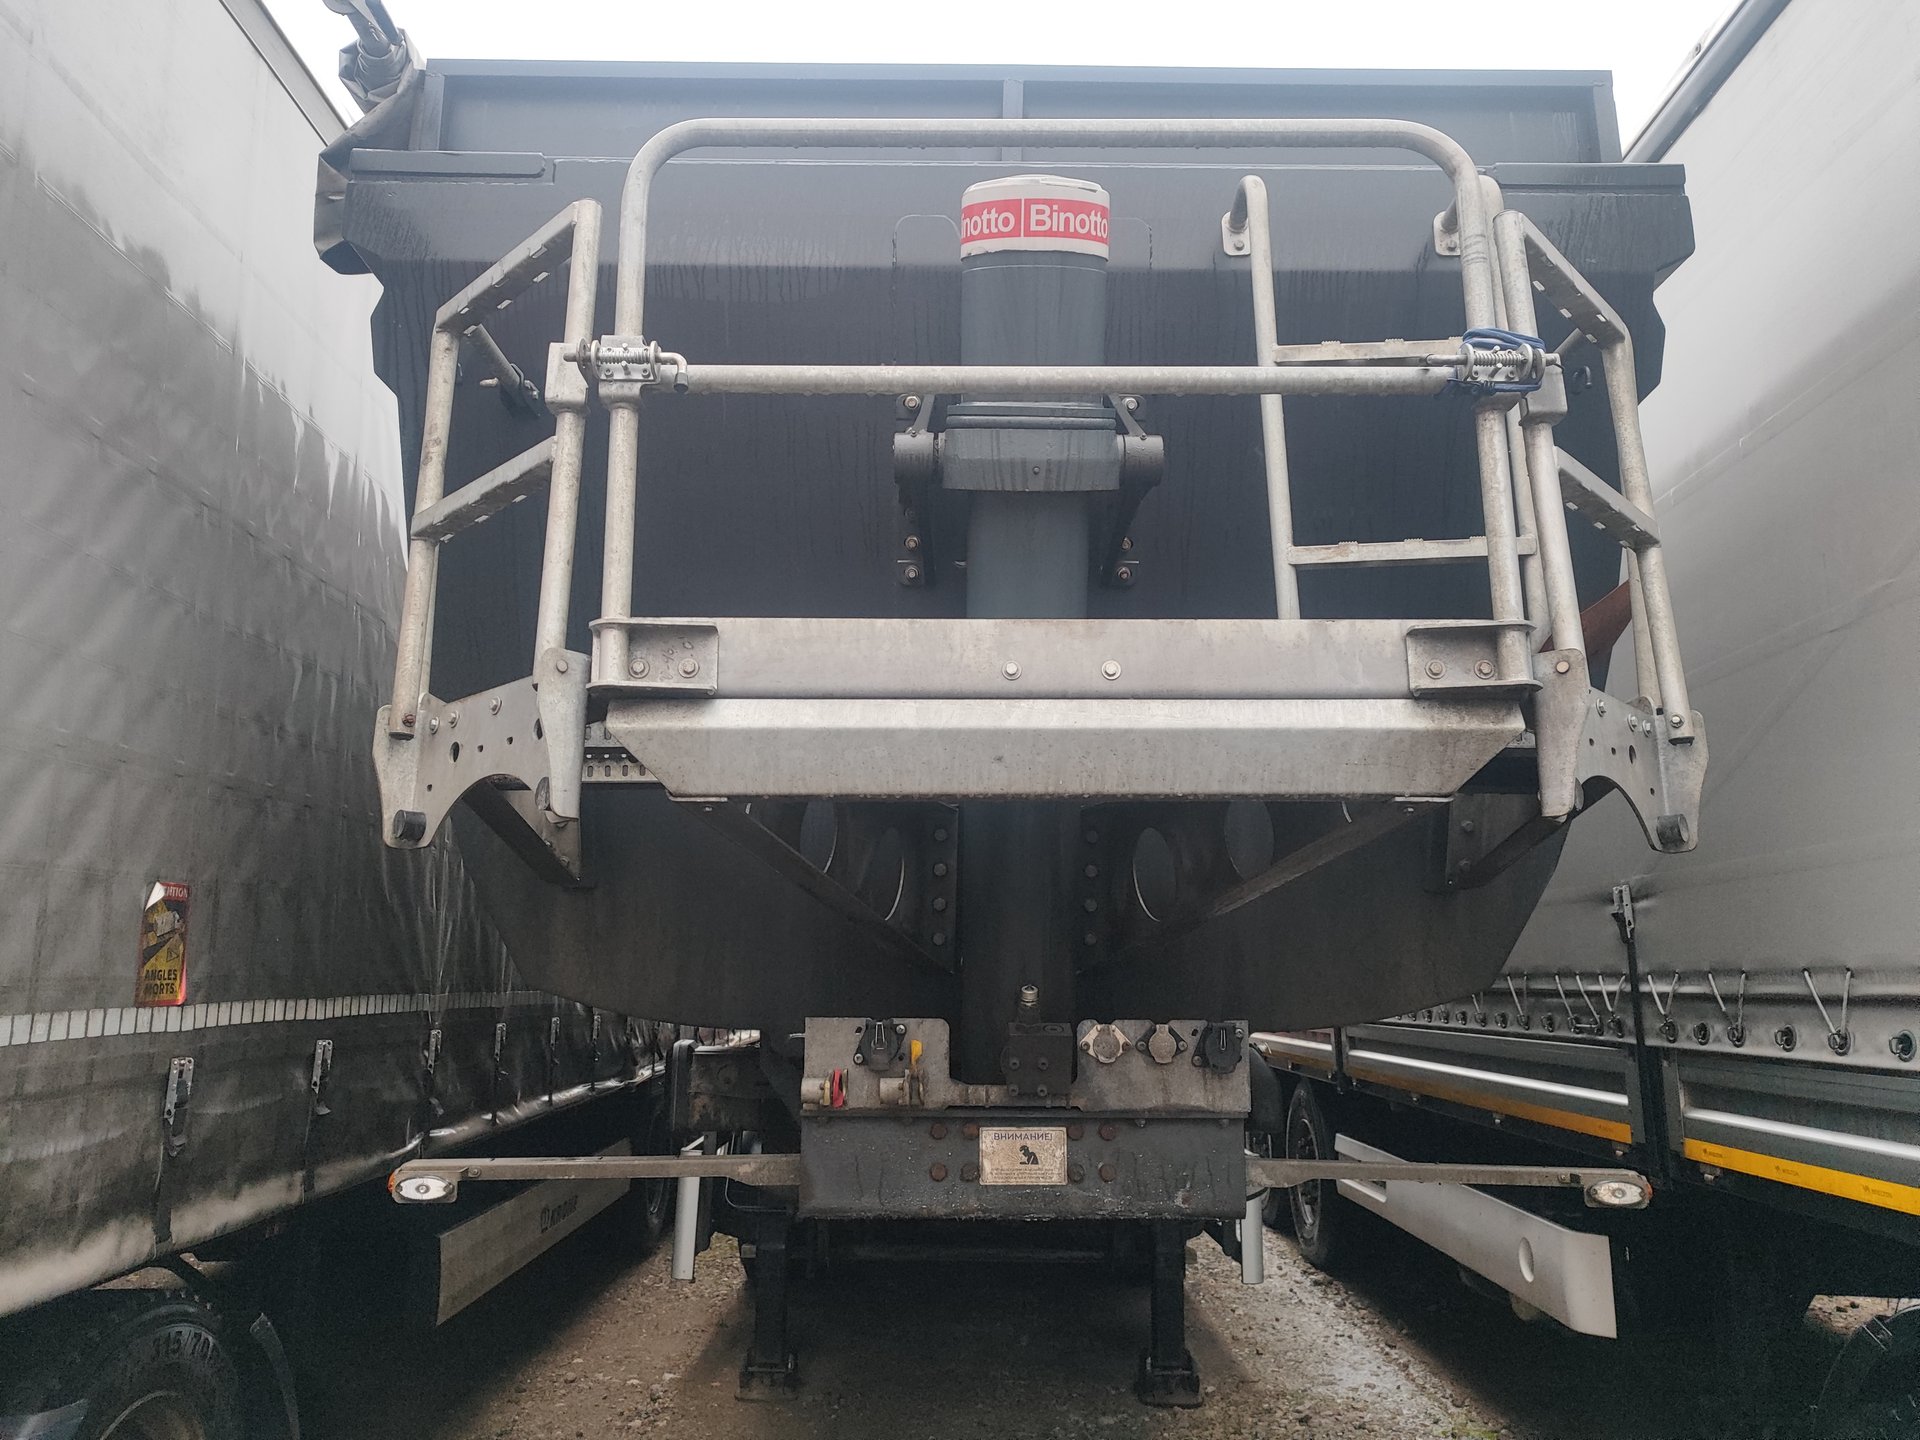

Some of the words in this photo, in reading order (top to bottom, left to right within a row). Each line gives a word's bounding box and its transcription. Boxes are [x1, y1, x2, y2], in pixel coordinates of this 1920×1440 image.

[1029, 204, 1108, 239] Binotto
[164, 886, 188, 898] NTION
[144, 969, 178, 981] ANGLES
[143, 983, 175, 995] MORTS
